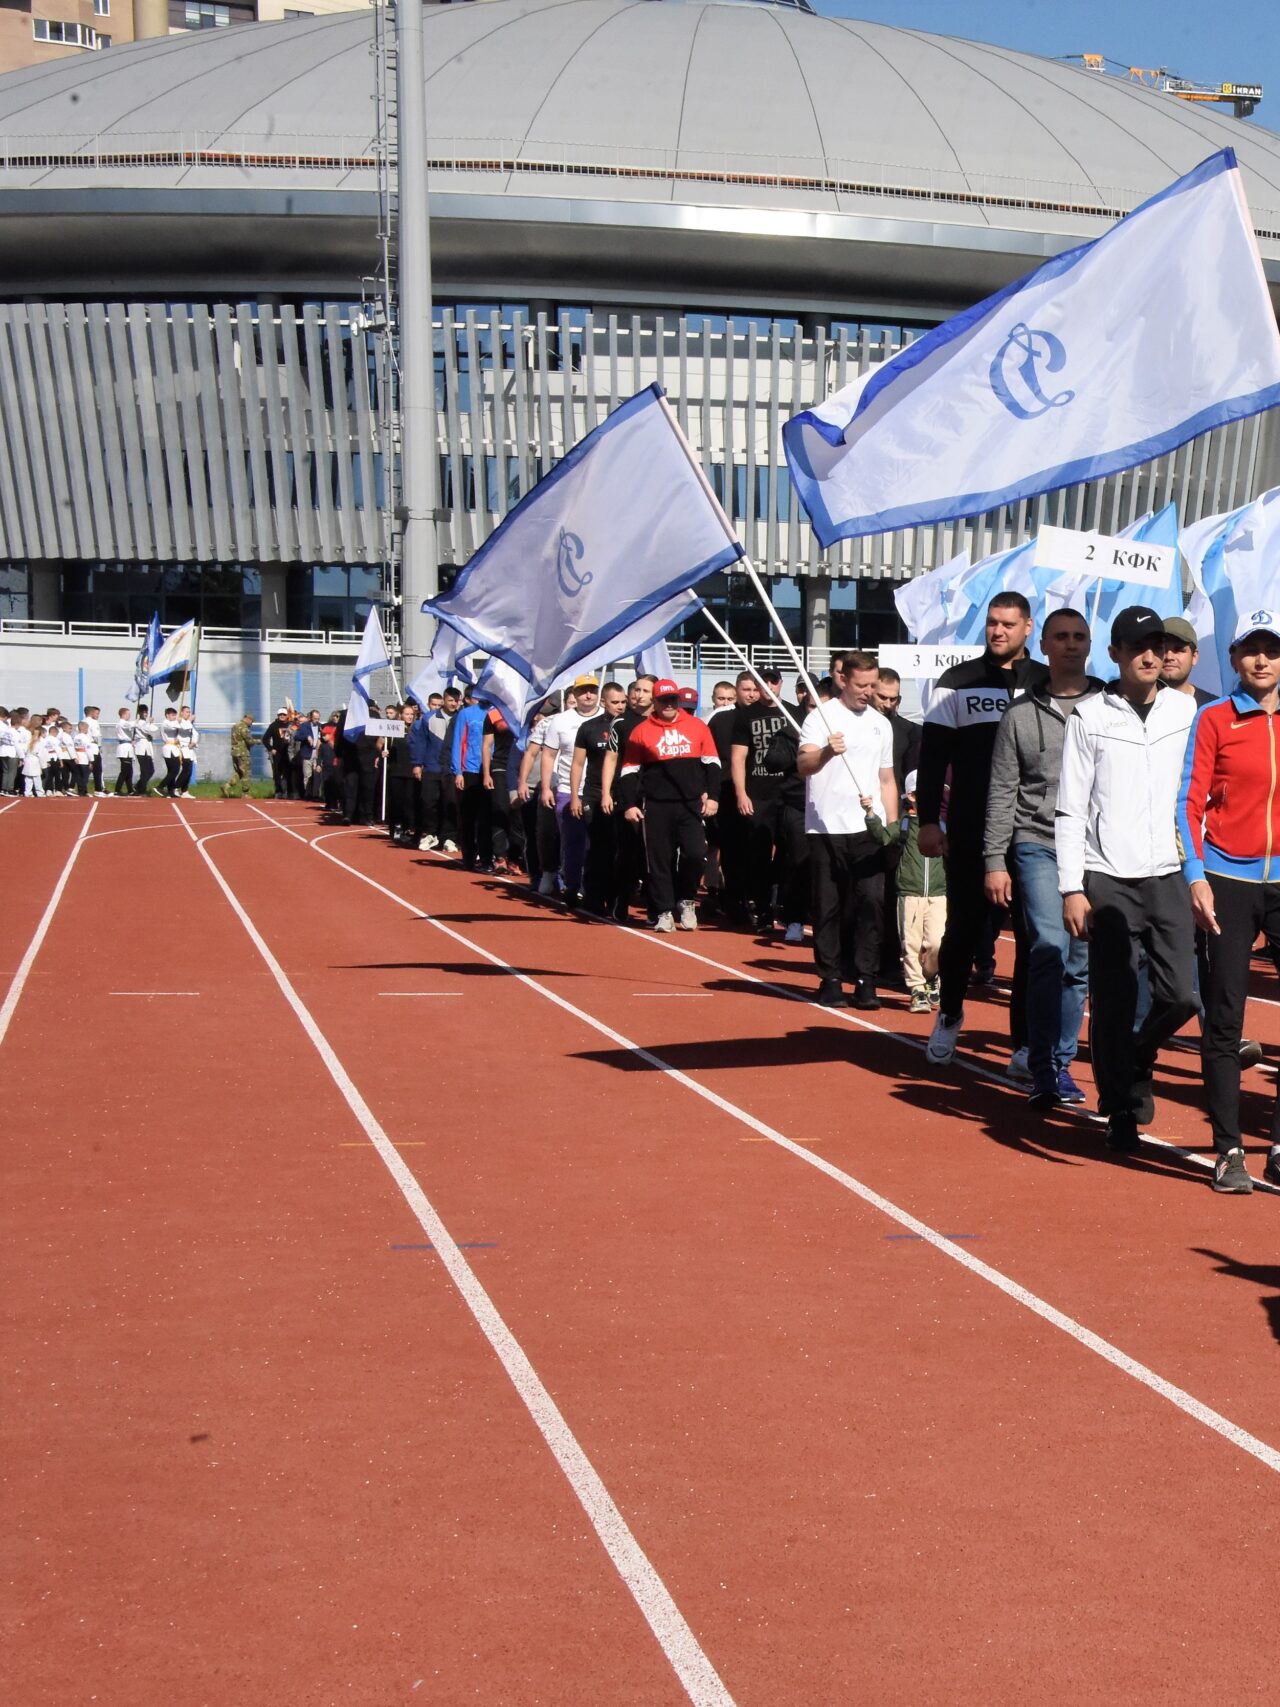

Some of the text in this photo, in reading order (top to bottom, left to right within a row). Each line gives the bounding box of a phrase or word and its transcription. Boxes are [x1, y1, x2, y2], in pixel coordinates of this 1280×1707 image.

[1085, 545, 1161, 572] 2 КФК
[913, 654, 921, 667] 3
[751, 717, 782, 736] OLD
[659, 744, 691, 756] Kappa
